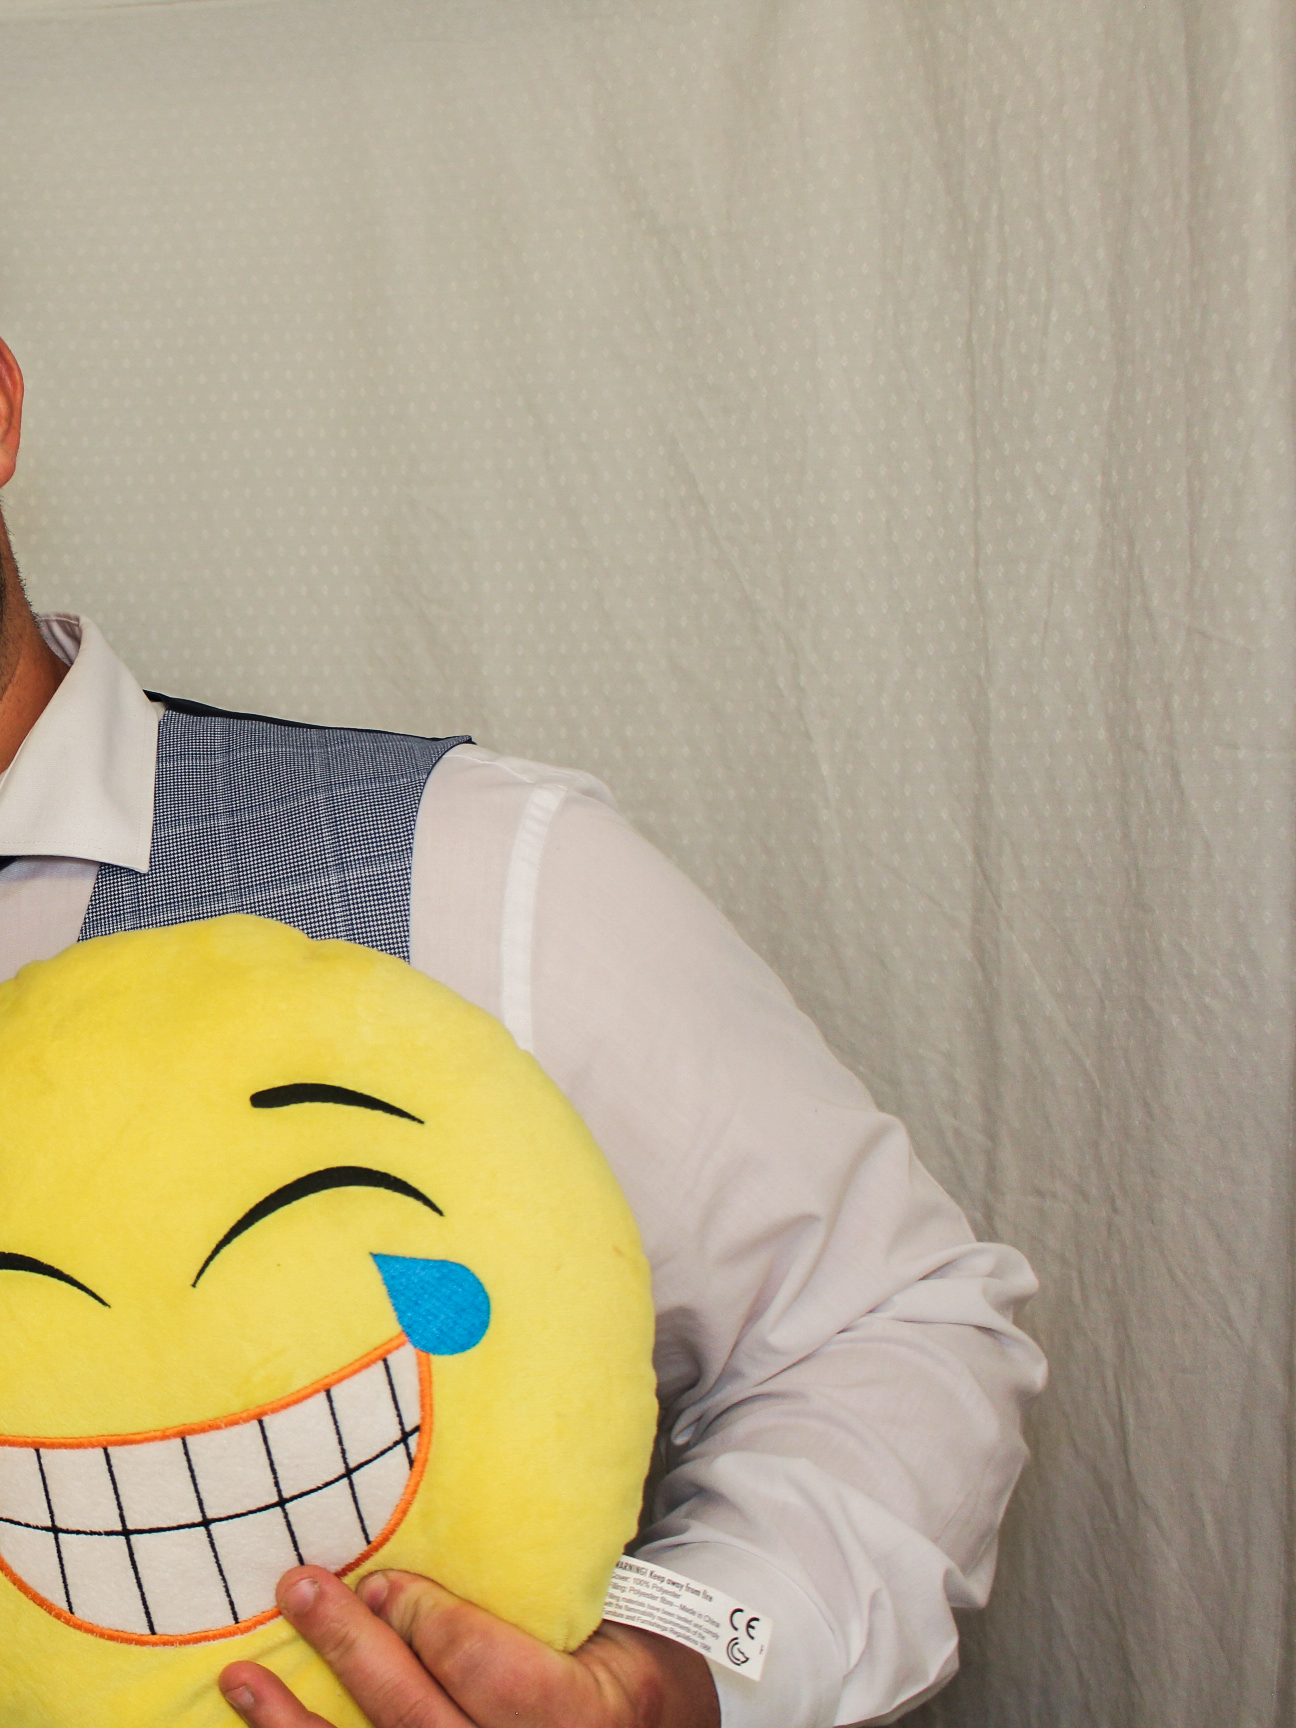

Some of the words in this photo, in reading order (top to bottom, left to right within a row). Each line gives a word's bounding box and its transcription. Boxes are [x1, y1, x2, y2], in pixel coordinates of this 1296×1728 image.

[633, 1577, 650, 1588] 100%
[651, 1583, 681, 1599] Polyester
[649, 1569, 665, 1584] Keep
[666, 1578, 684, 1591] away
[685, 1582, 701, 1597] from
[701, 1589, 713, 1602] fire
[629, 1586, 659, 1601] Polyester
[679, 1603, 696, 1616] Made
[704, 1614, 720, 1628] China
